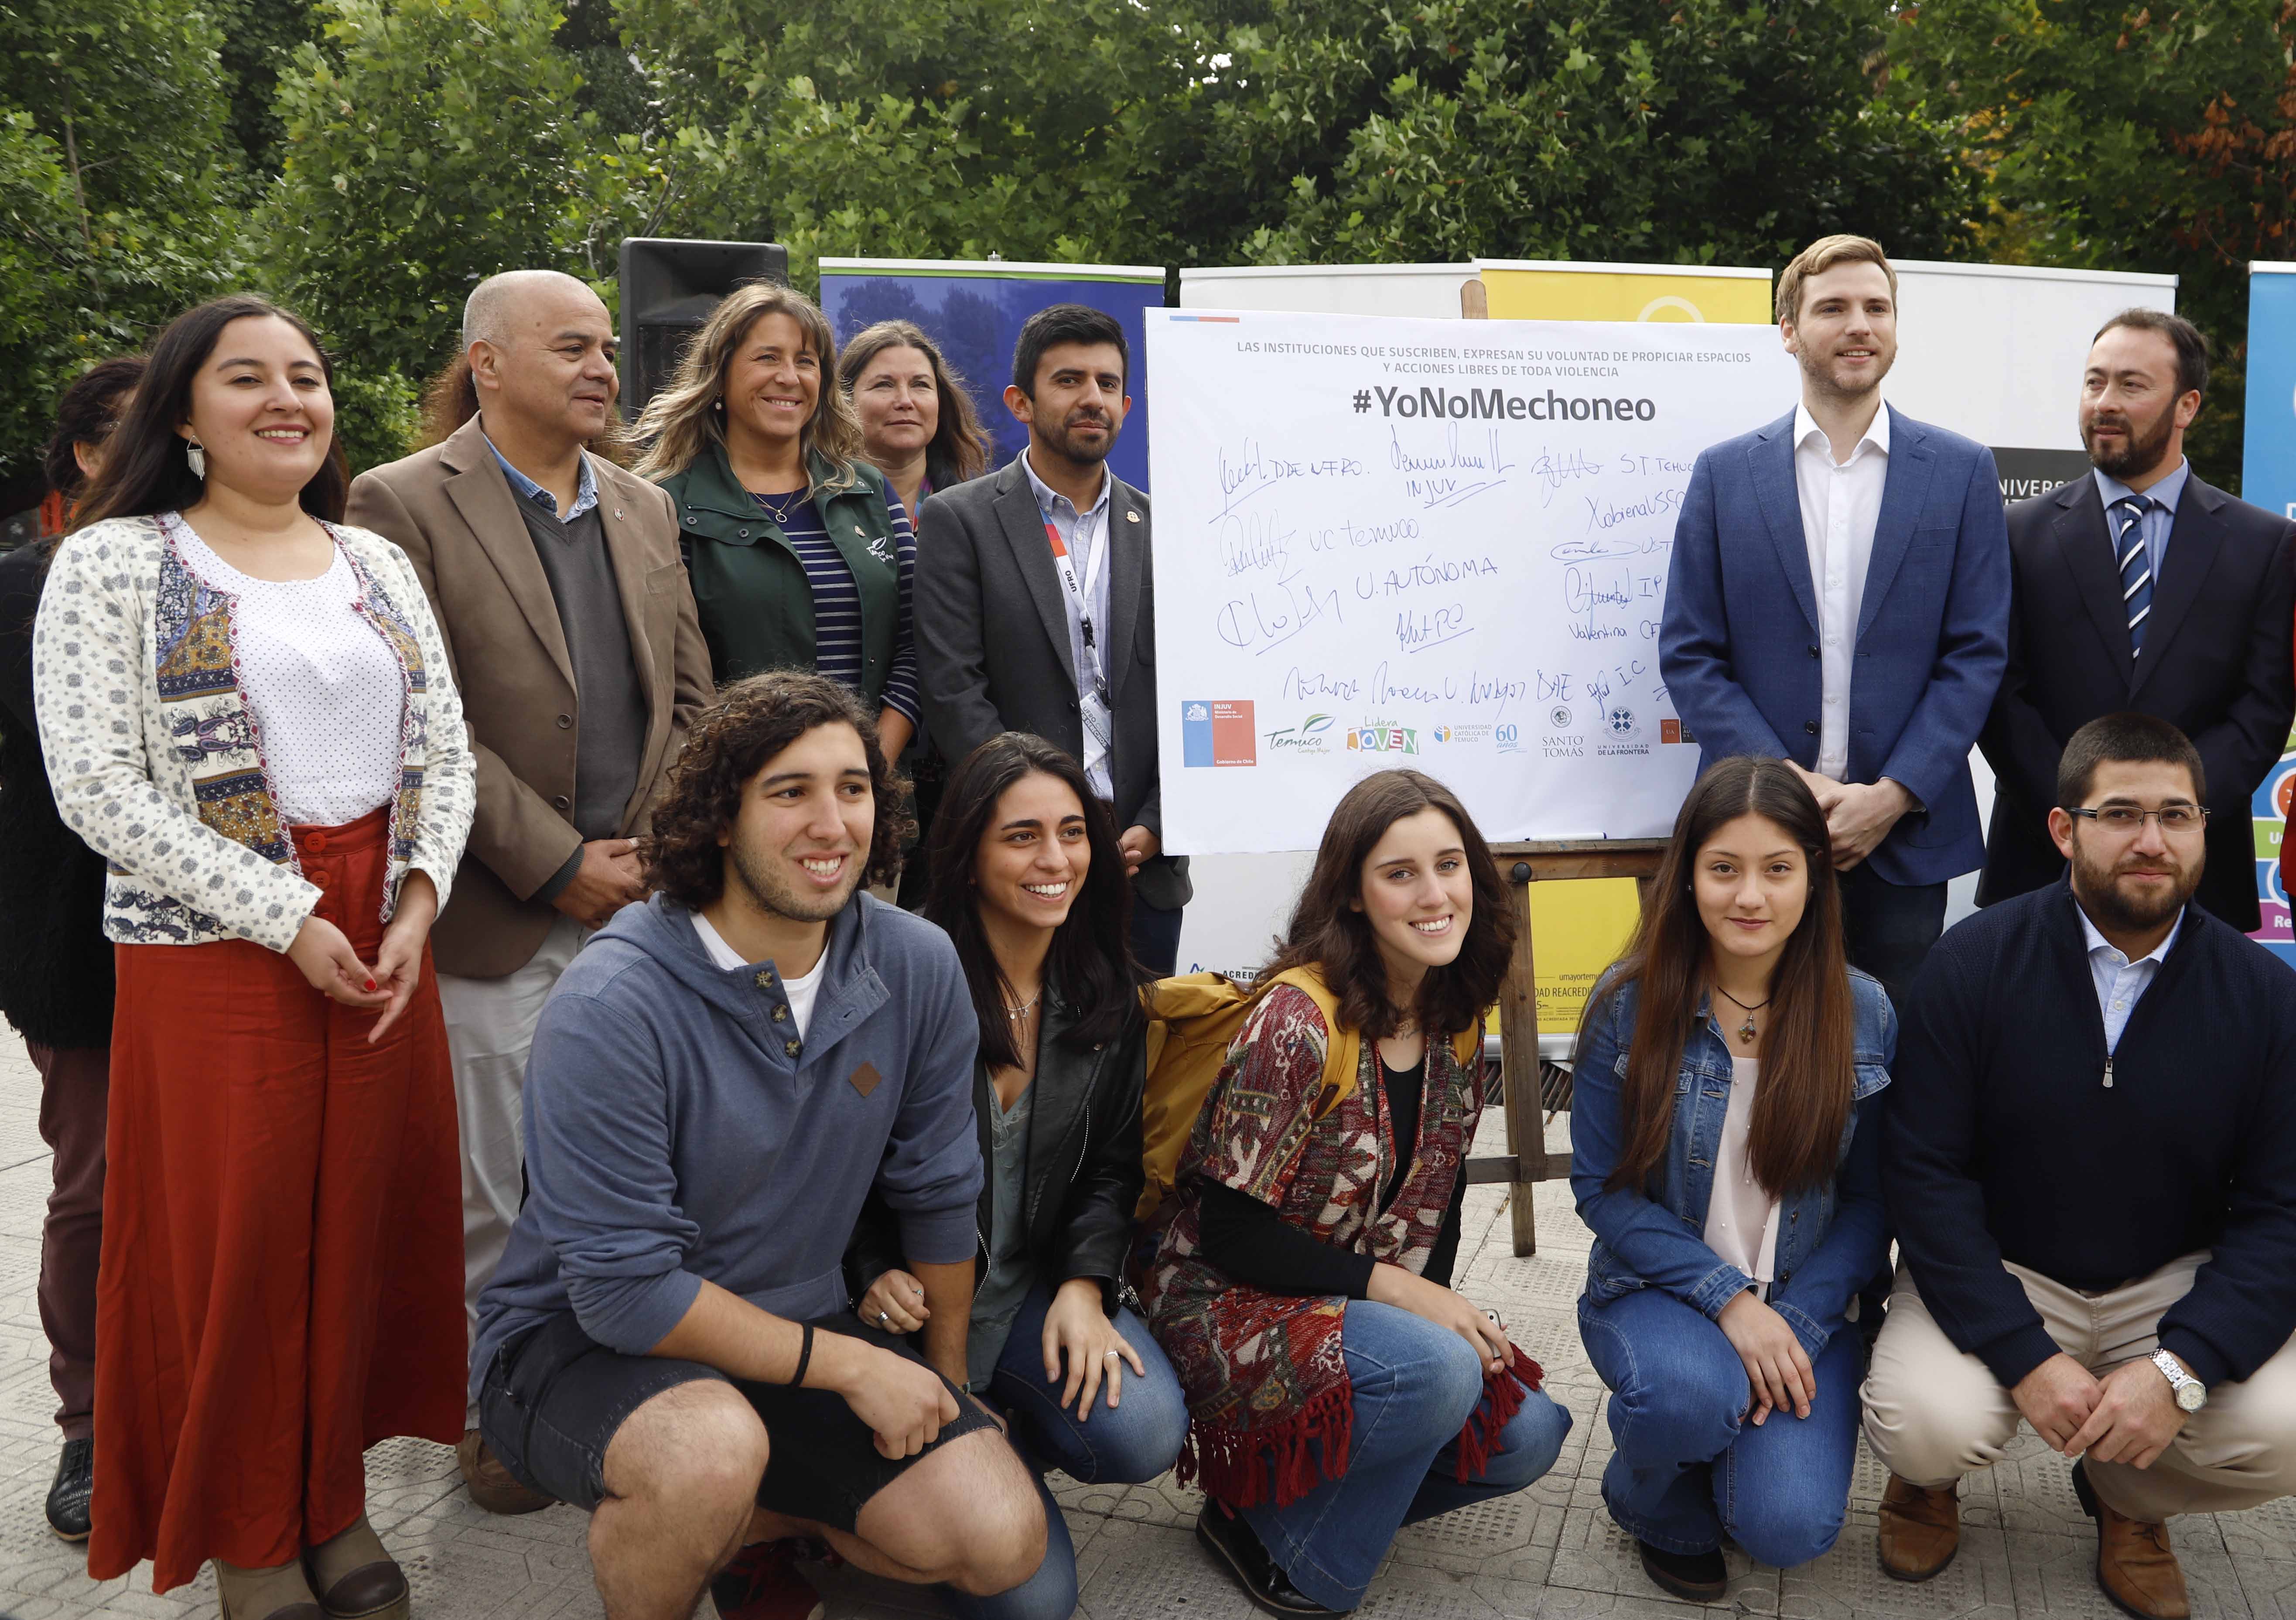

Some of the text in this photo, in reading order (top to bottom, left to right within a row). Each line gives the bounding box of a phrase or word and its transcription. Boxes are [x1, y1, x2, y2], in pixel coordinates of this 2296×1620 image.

[1237, 342, 1751, 364] LAS INSTITUCIONES QUE SUSCRIBEN, EXPRESAN SU VOLUNTAD DE PROPICIAR ESPACIOS
[1383, 362, 1619, 377] Y ACCIONES LIBRES DE TODA VIOLENCIA
[1353, 386, 1656, 421] #YoNoMechoneo
[1065, 570, 1077, 593] UFRO
[1568, 621, 1628, 641] Valentina
[1083, 706, 1096, 723] UFRO
[1085, 719, 1107, 747] DERECHOS
[1264, 728, 1323, 750] Temuco
[1347, 727, 1420, 755] JOVEN
[1496, 724, 1518, 742] 60
[1542, 736, 1583, 747] SANTO
[1496, 740, 1519, 748] años
[1543, 745, 1584, 758] TOMÁS
